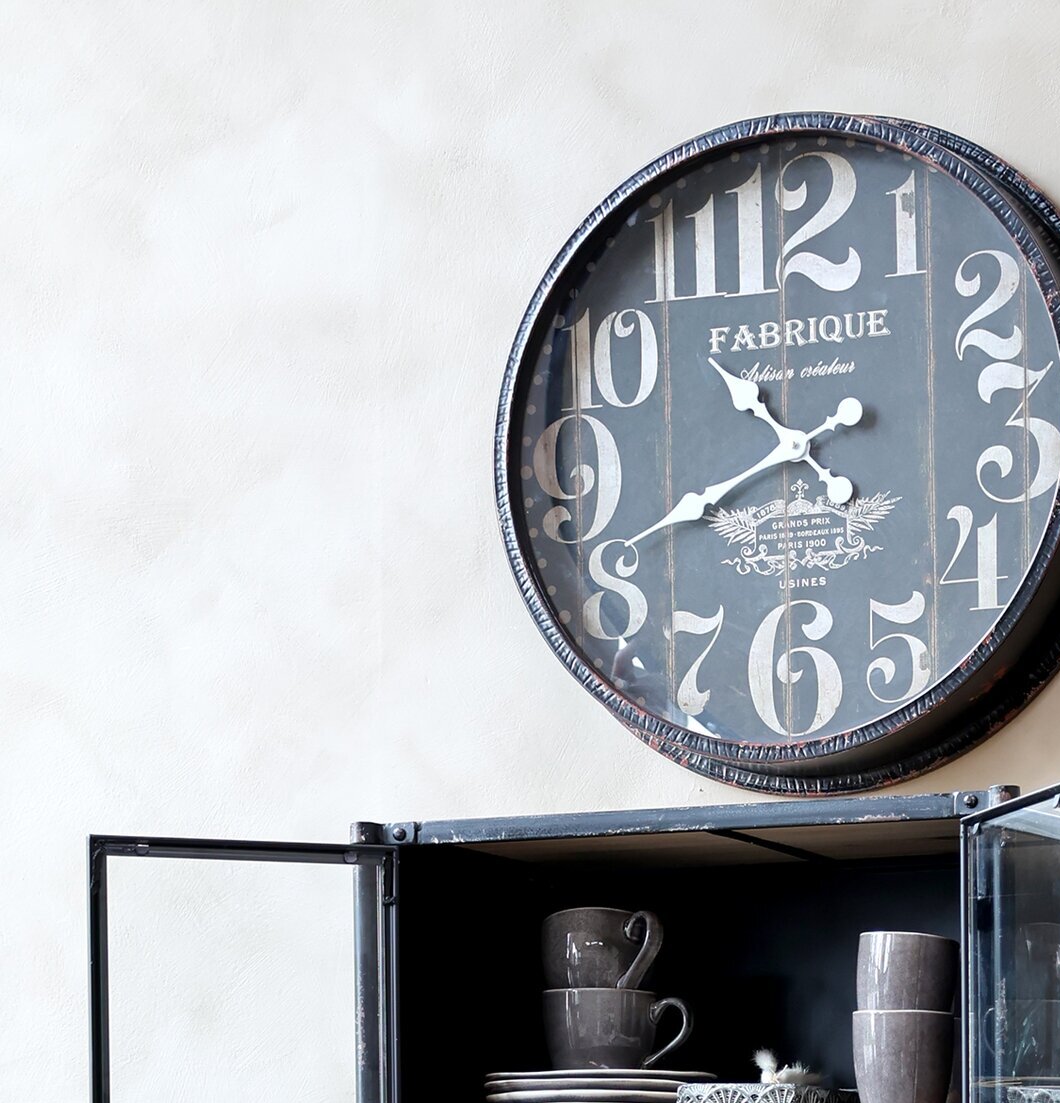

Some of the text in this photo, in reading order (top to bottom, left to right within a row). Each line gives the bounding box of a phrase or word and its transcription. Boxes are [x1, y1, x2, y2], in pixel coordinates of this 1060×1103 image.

[723, 151, 862, 298] 12
[884, 169, 928, 278] 1
[708, 309, 891, 355] FABRIQUE
[954, 249, 1024, 361] 2
[561, 307, 658, 412] 10
[740, 361, 795, 383] Artisan
[533, 414, 622, 543] 9
[771, 517, 831, 530] GRANDS PRIX
[582, 539, 648, 640] 8
[758, 532, 778, 541] PARIS
[777, 538, 827, 550] PARIS 1900
[778, 577, 827, 589] USINES
[939, 504, 1007, 611] 4
[662, 604, 724, 716] 7
[748, 599, 843, 737] 6
[866, 590, 932, 703] 5
